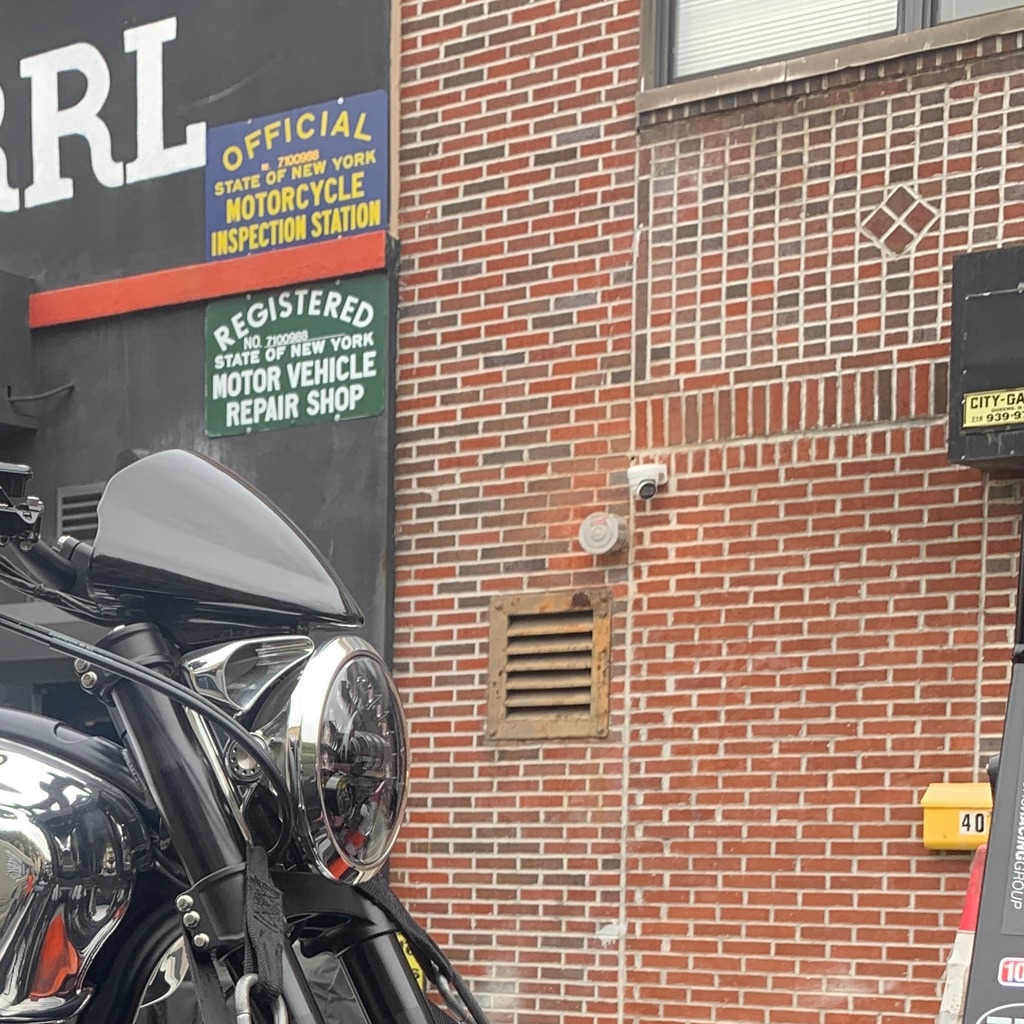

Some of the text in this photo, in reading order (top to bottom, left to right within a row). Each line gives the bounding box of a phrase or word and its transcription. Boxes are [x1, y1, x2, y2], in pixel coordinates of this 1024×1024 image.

[222, 110, 372, 171] OFFICIAL
[214, 149, 377, 196] STATE OF NEW YORK
[226, 172, 365, 224] MOTORCYCLE
[211, 199, 381, 257] INSPECTION STATION
[213, 289, 374, 352] REGISTERED
[243, 334, 263, 350] NO.
[214, 331, 374, 369] STATE OF NEW YORK
[212, 350, 377, 400] MOTOR VEHICLE
[226, 384, 365, 427] REPAIR SHOP
[961, 813, 984, 833] 40
